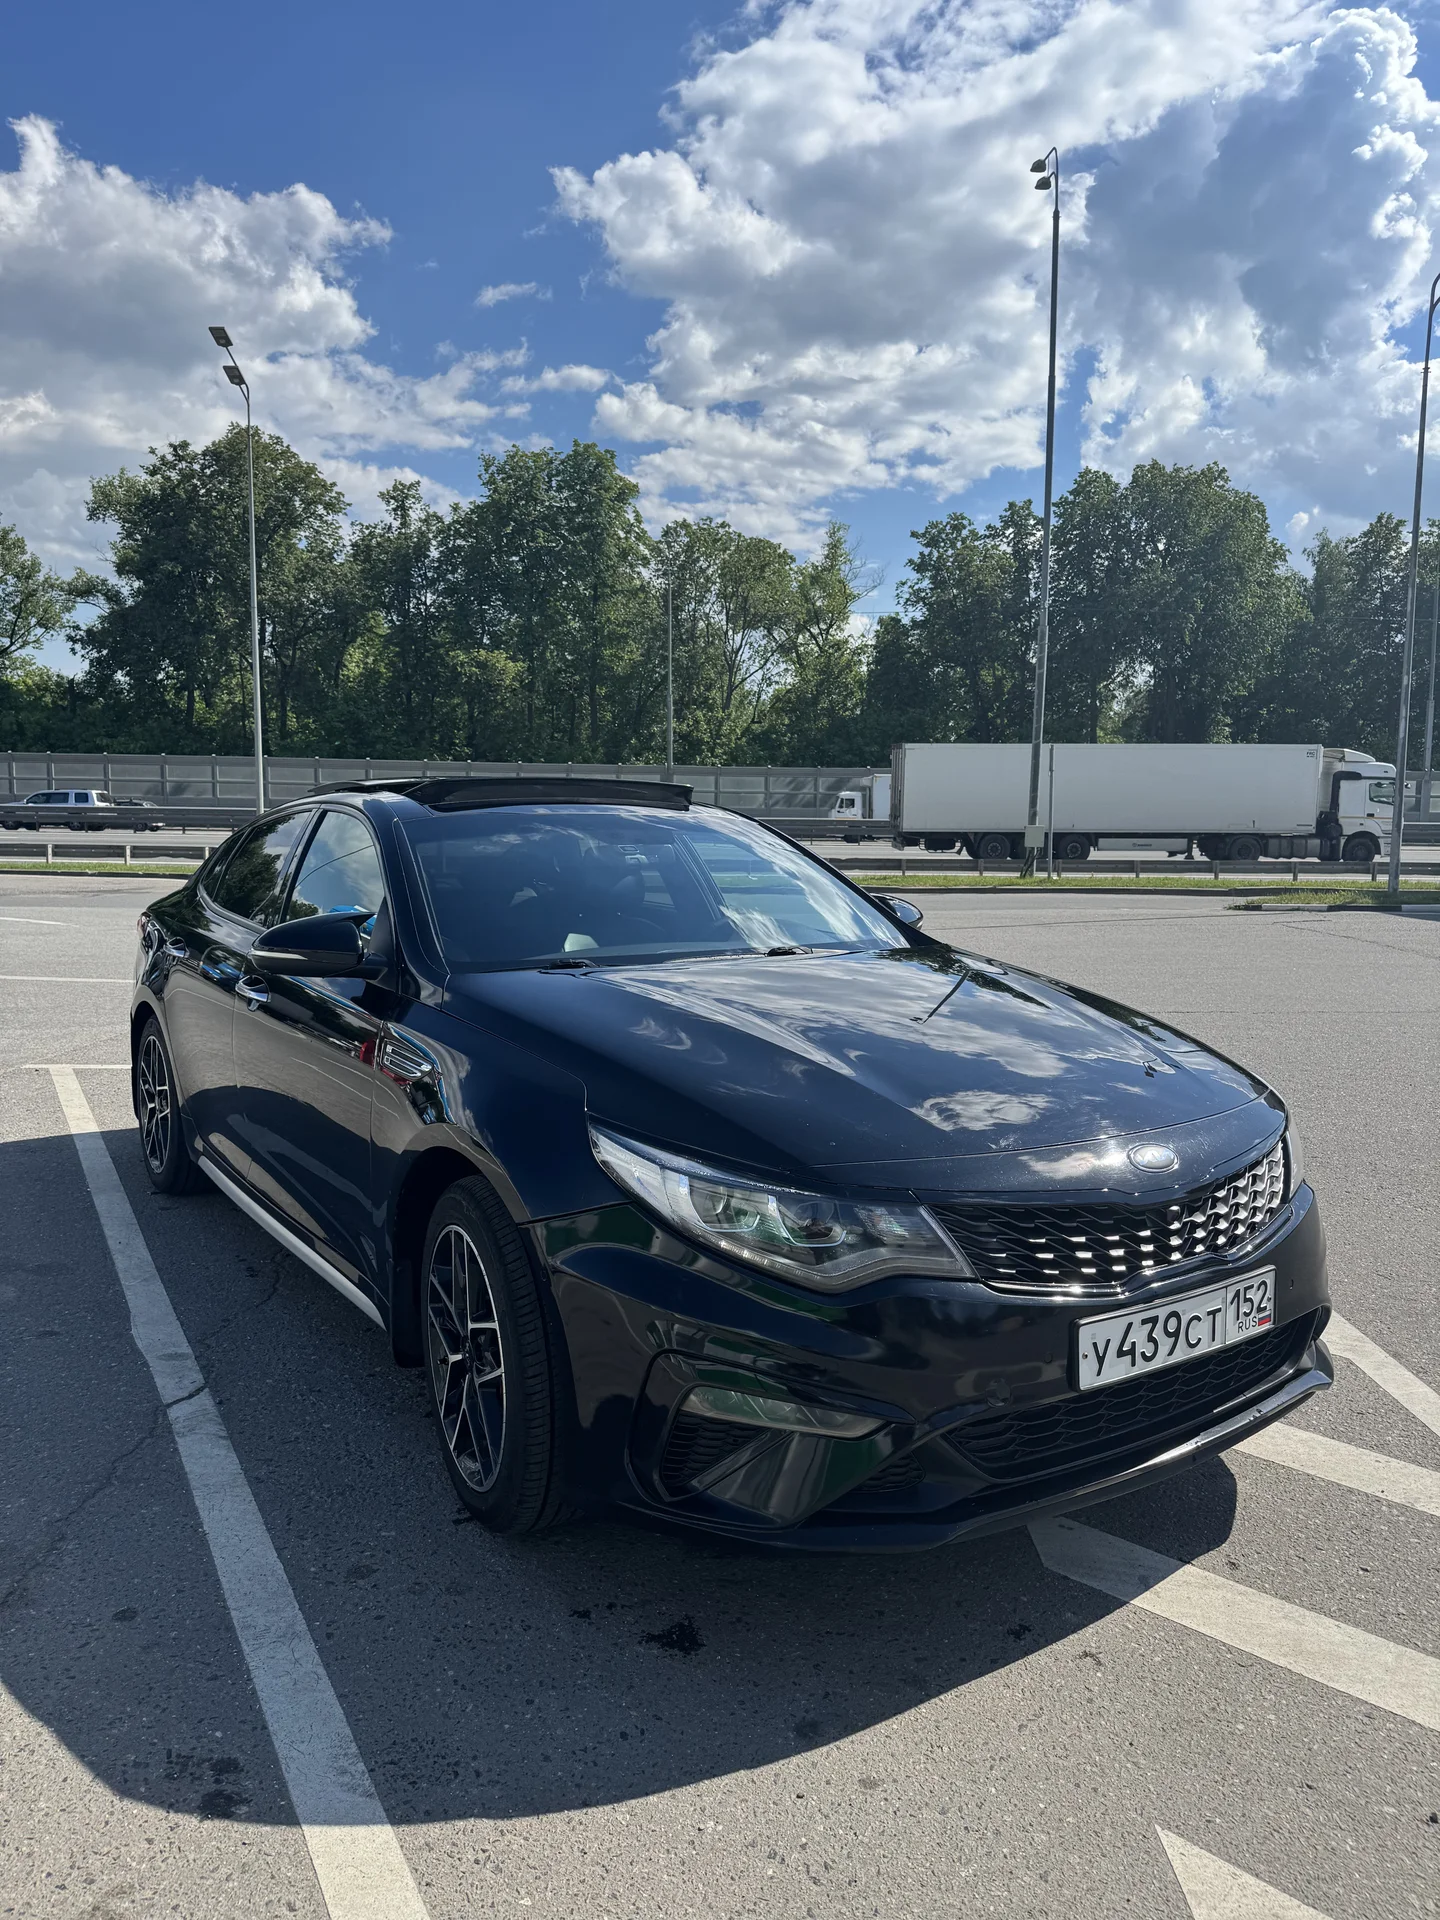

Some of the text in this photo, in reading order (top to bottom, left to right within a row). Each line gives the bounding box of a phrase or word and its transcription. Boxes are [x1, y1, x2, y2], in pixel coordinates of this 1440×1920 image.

[1092, 1280, 1268, 1377] У439СТ 152
[1237, 1315, 1258, 1333] RUS
